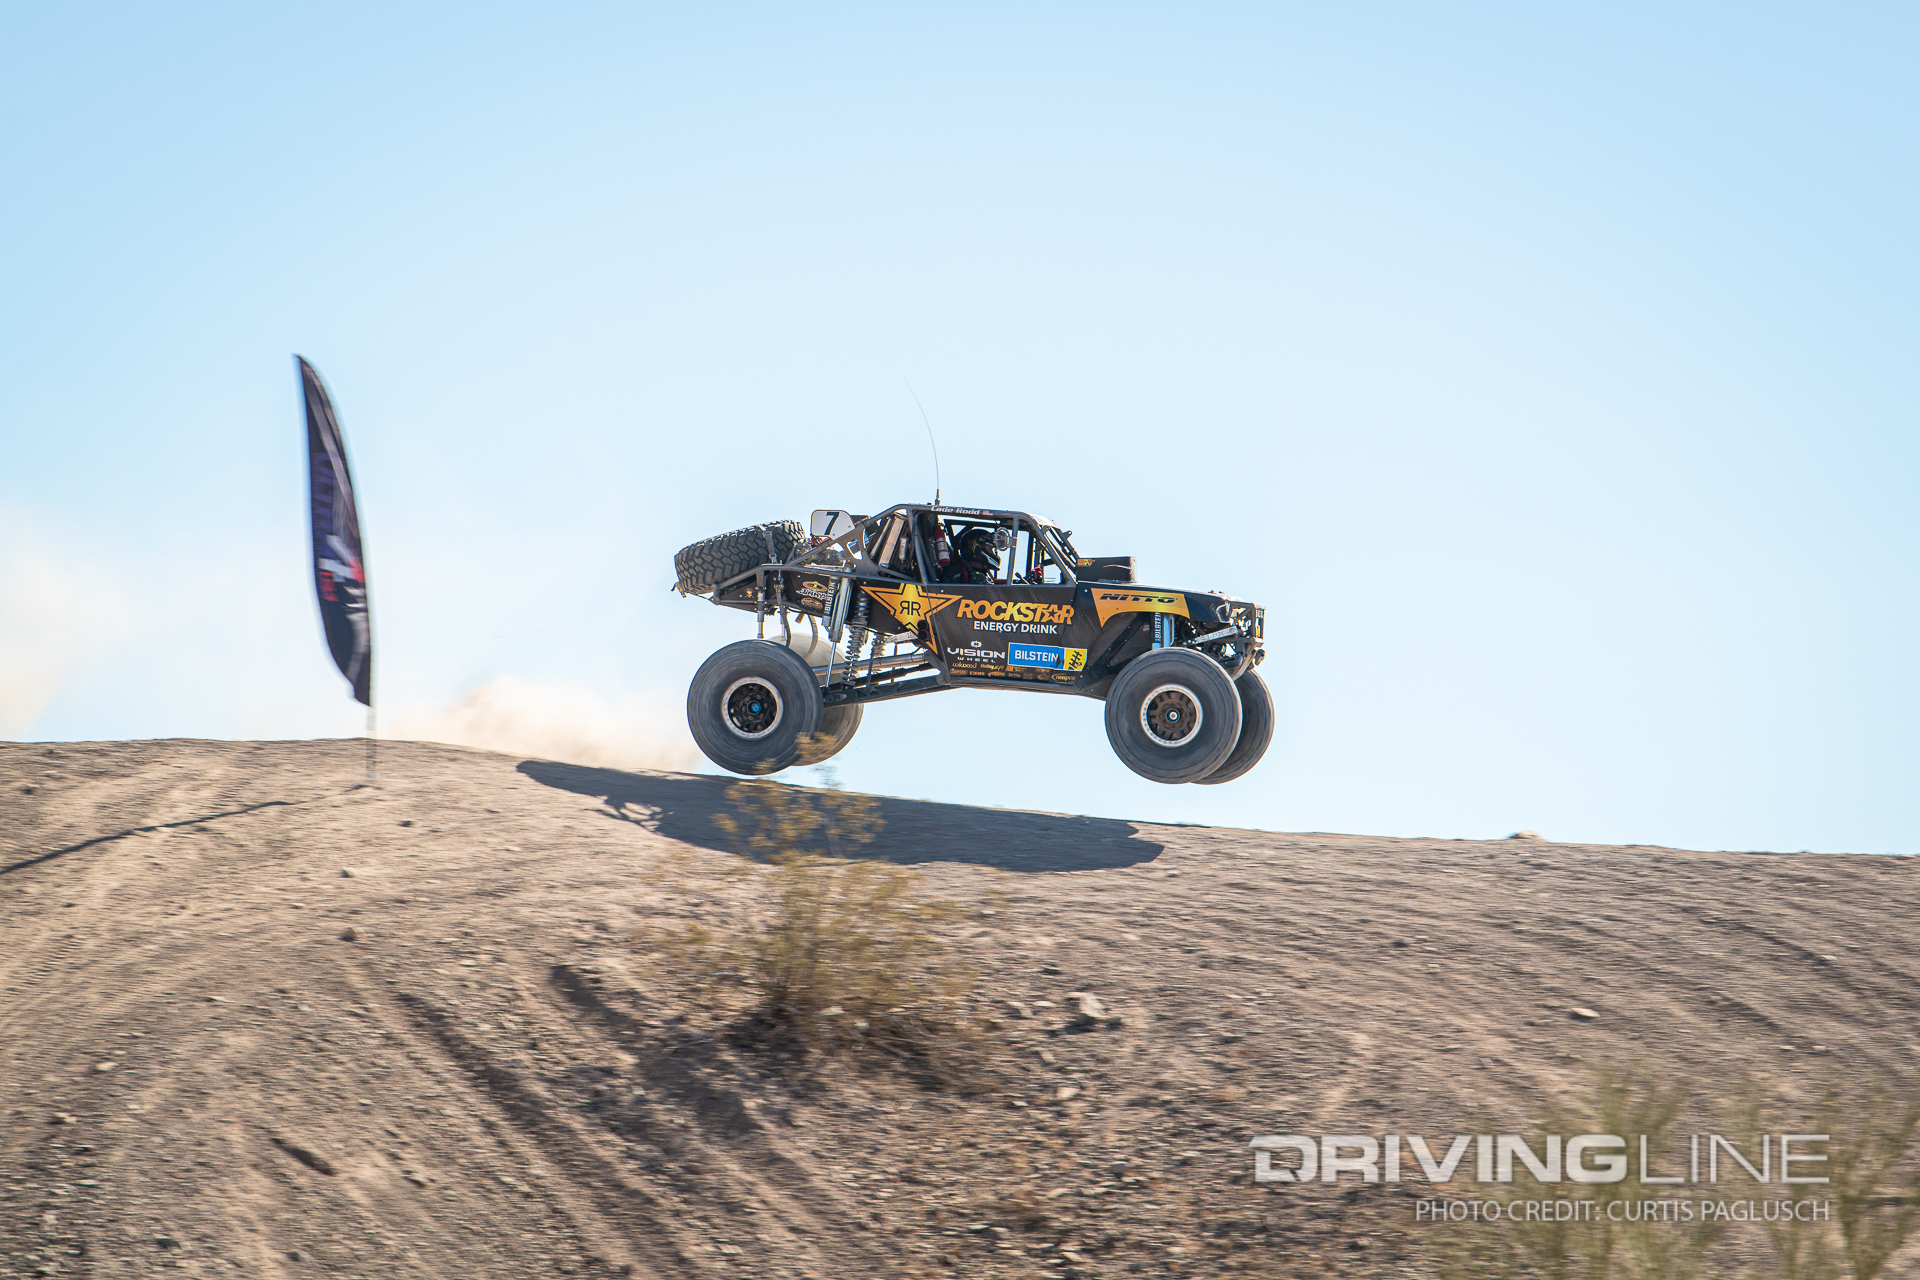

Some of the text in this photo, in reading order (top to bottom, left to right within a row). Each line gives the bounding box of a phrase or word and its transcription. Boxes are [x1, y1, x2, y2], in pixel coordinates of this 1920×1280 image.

[931, 505, 954, 513] Cade
[824, 511, 840, 535] 7
[824, 581, 836, 612] BILSTEIN
[1100, 593, 1175, 603] NITTO
[957, 599, 1075, 625] ROCKSTAR
[973, 621, 1058, 634] ENERGY DRINK
[947, 646, 1006, 659] VISION
[1014, 649, 1059, 662] BILSTEIN
